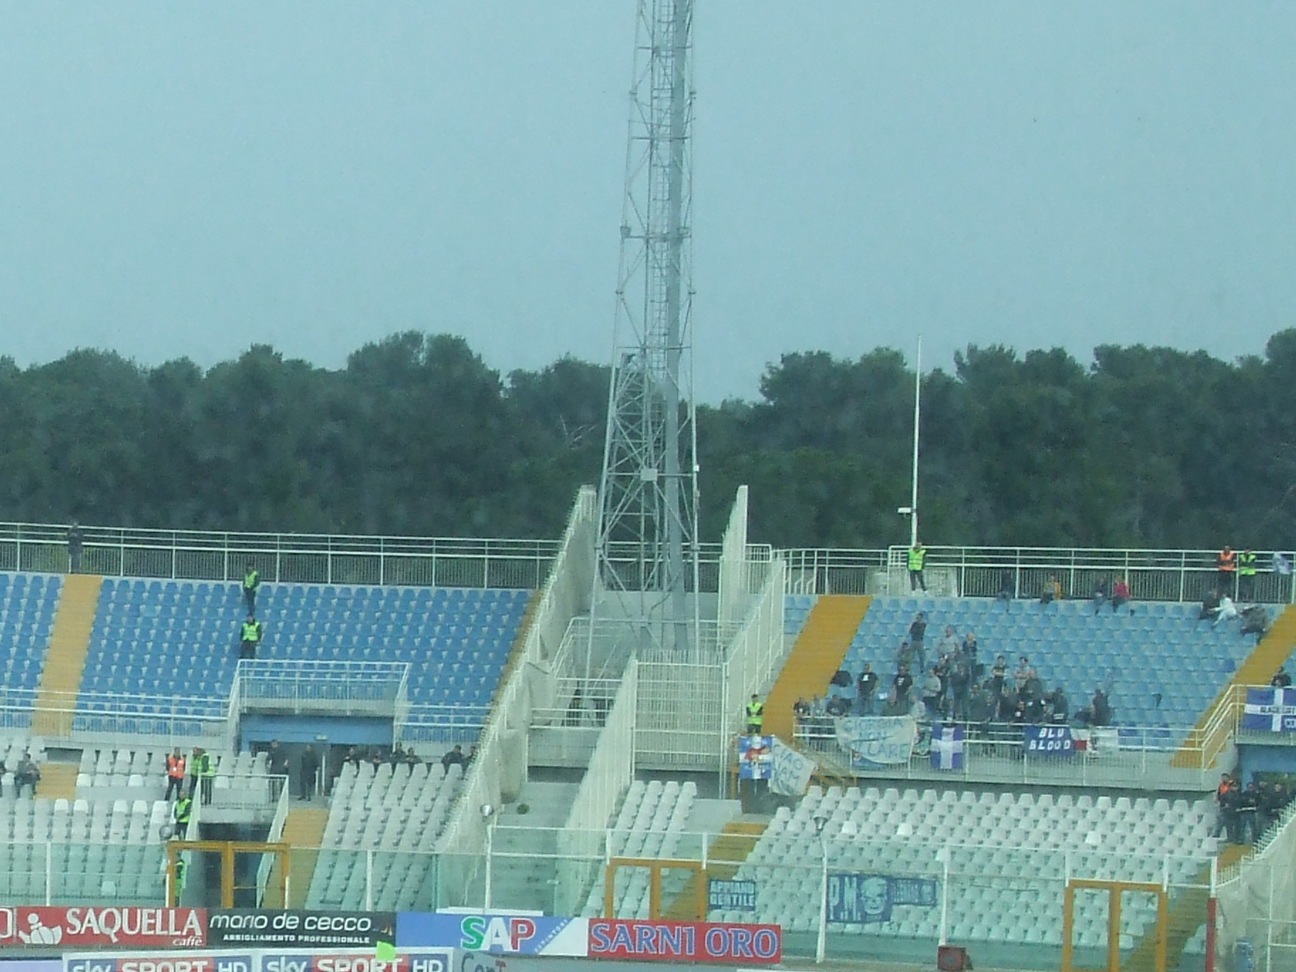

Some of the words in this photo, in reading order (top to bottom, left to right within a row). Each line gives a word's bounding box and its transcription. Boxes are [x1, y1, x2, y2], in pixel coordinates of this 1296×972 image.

[1029, 739, 1071, 750] BLOOD
[1039, 727, 1065, 738] BLU
[65, 907, 203, 943] SAQUELLA
[209, 914, 268, 930] mario
[272, 912, 300, 930] de
[304, 915, 372, 932] cecco
[460, 916, 537, 952] SAP
[591, 923, 695, 956] SARNI
[705, 927, 779, 959] ORO
